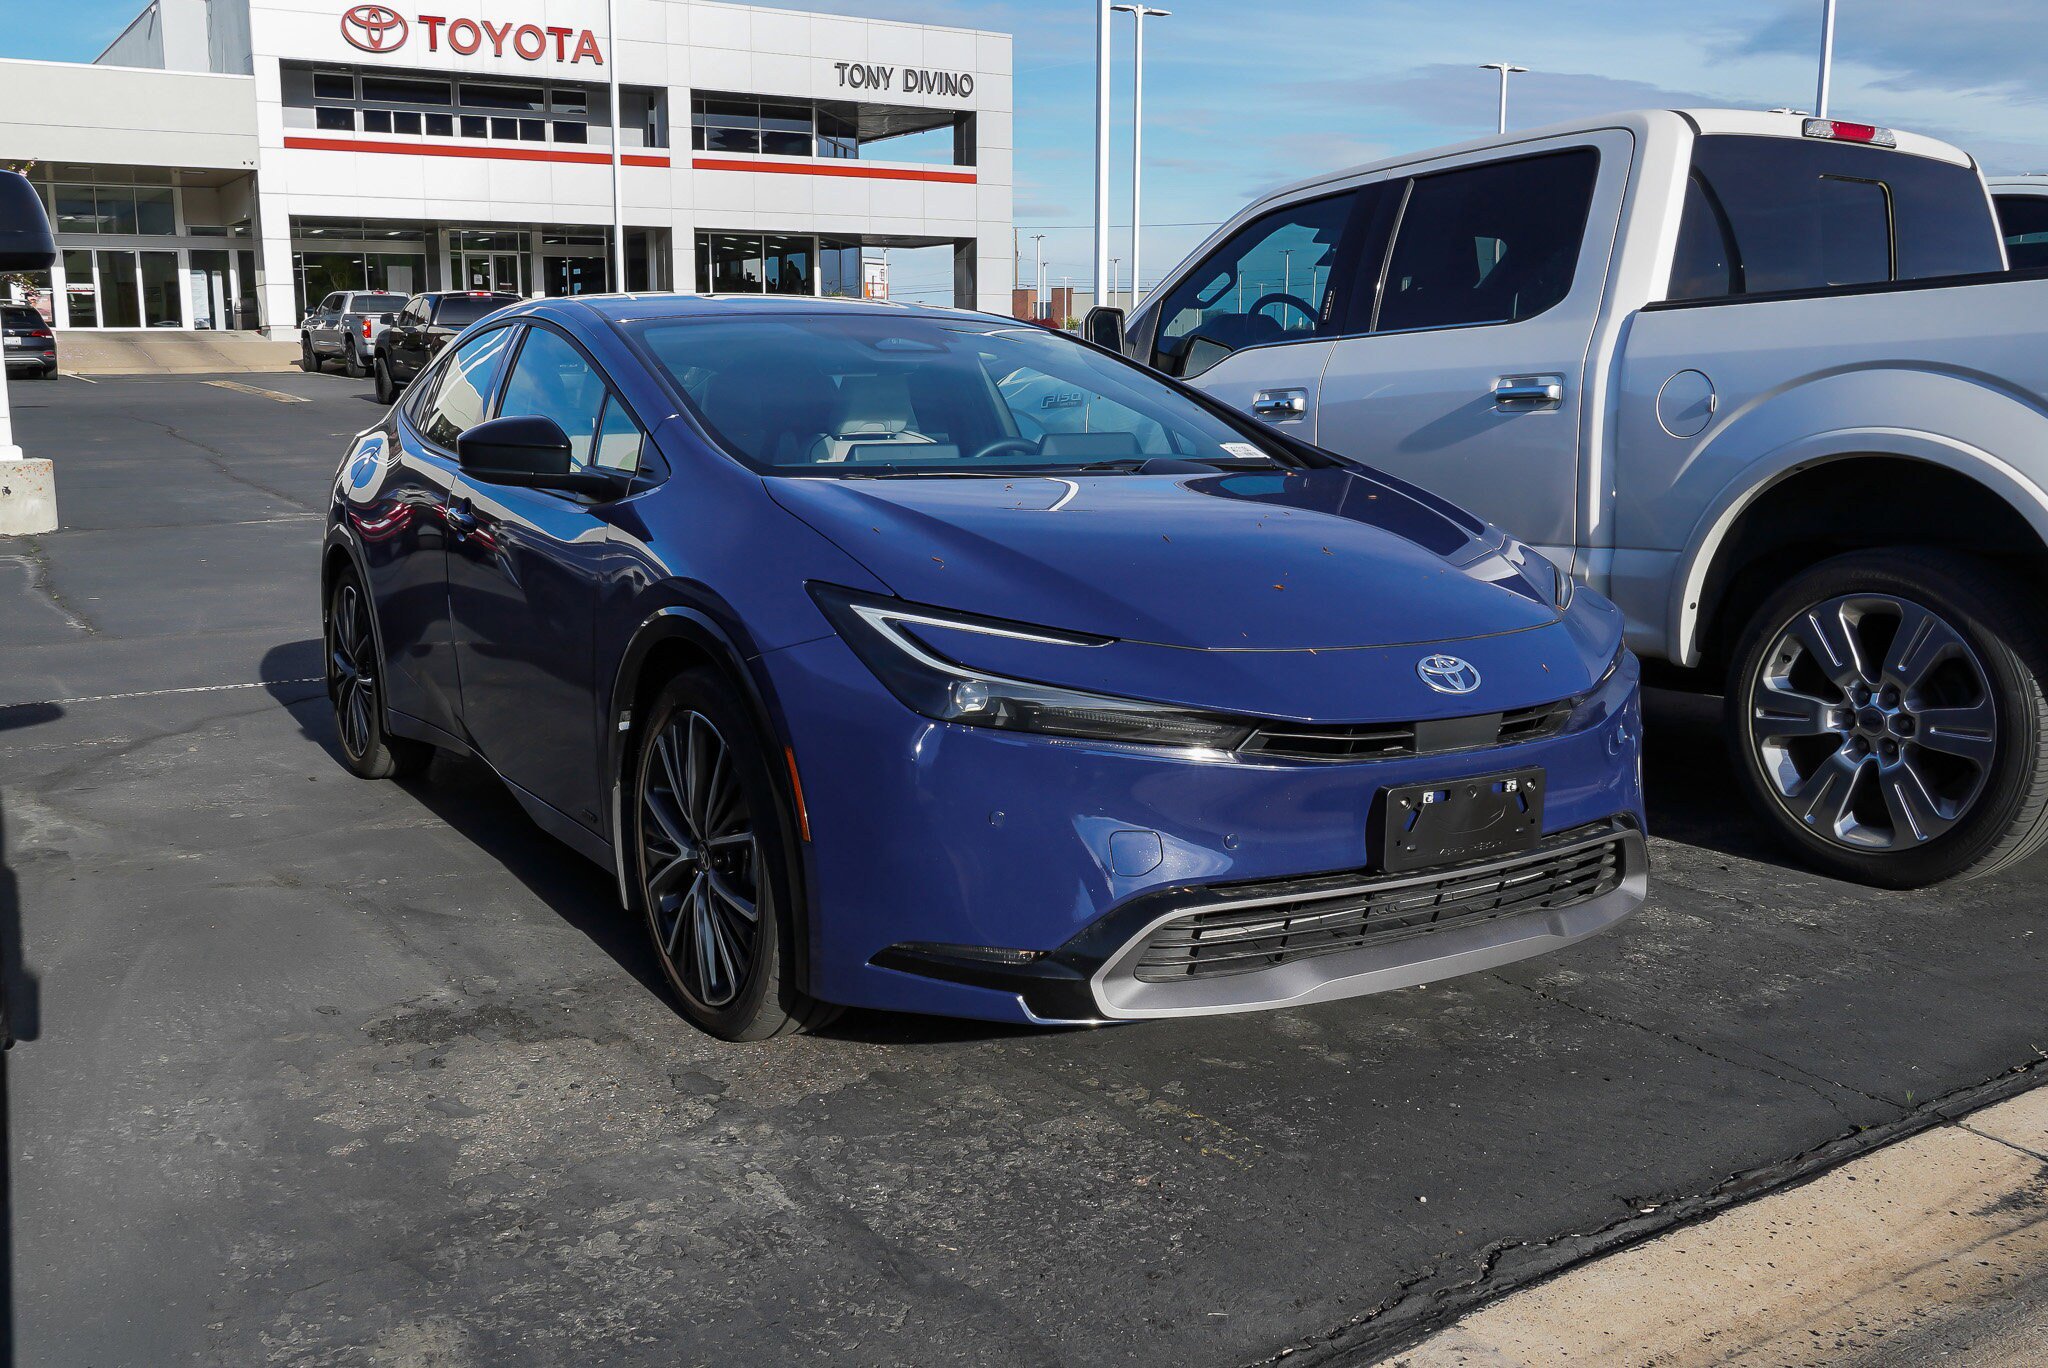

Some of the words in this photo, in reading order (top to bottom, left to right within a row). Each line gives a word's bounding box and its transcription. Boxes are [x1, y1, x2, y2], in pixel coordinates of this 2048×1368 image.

[418, 15, 604, 65] TOYOTA
[834, 62, 894, 90] TONY
[903, 69, 974, 98] DIVINO
